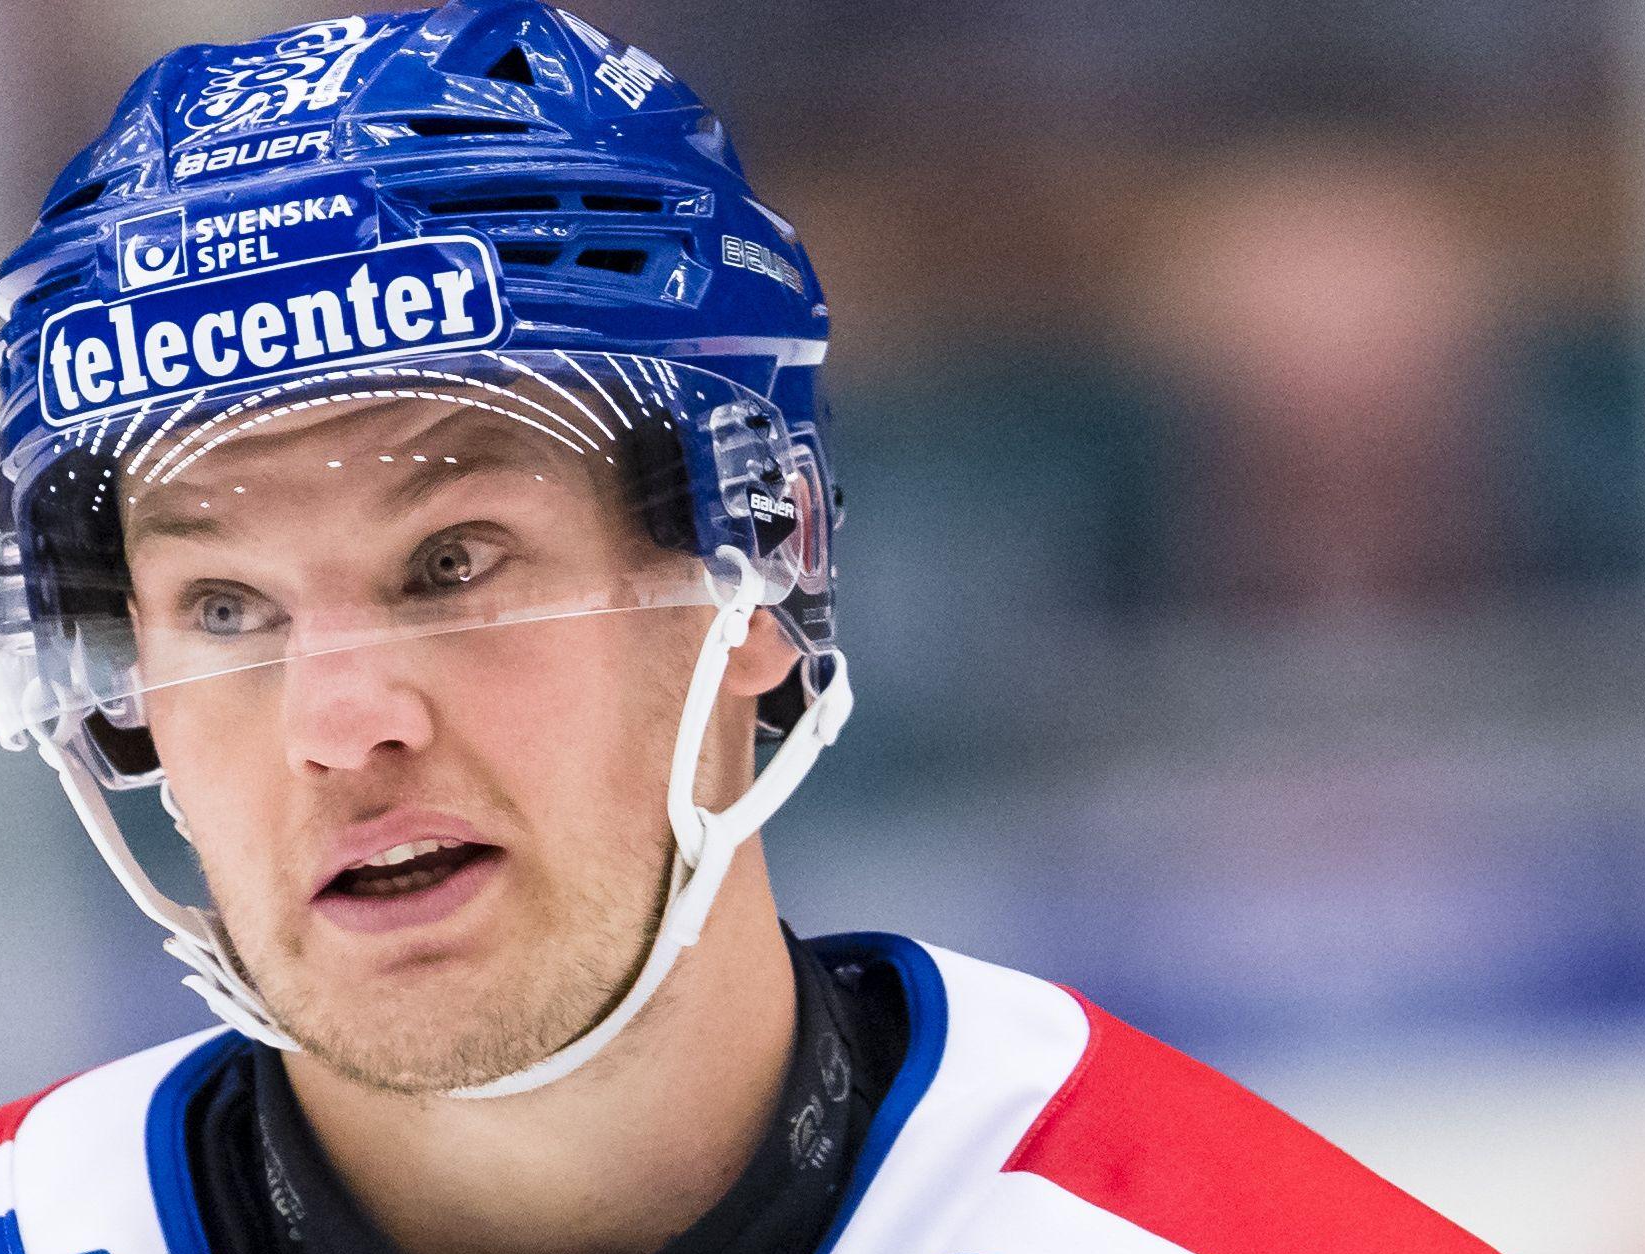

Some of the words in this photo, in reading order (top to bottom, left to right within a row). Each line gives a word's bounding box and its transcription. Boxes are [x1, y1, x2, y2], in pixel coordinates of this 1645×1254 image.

[175, 131, 331, 178] BAUER
[196, 195, 353, 243] SVENSKA
[198, 235, 278, 273] SPEL
[50, 263, 474, 410] telecenter
